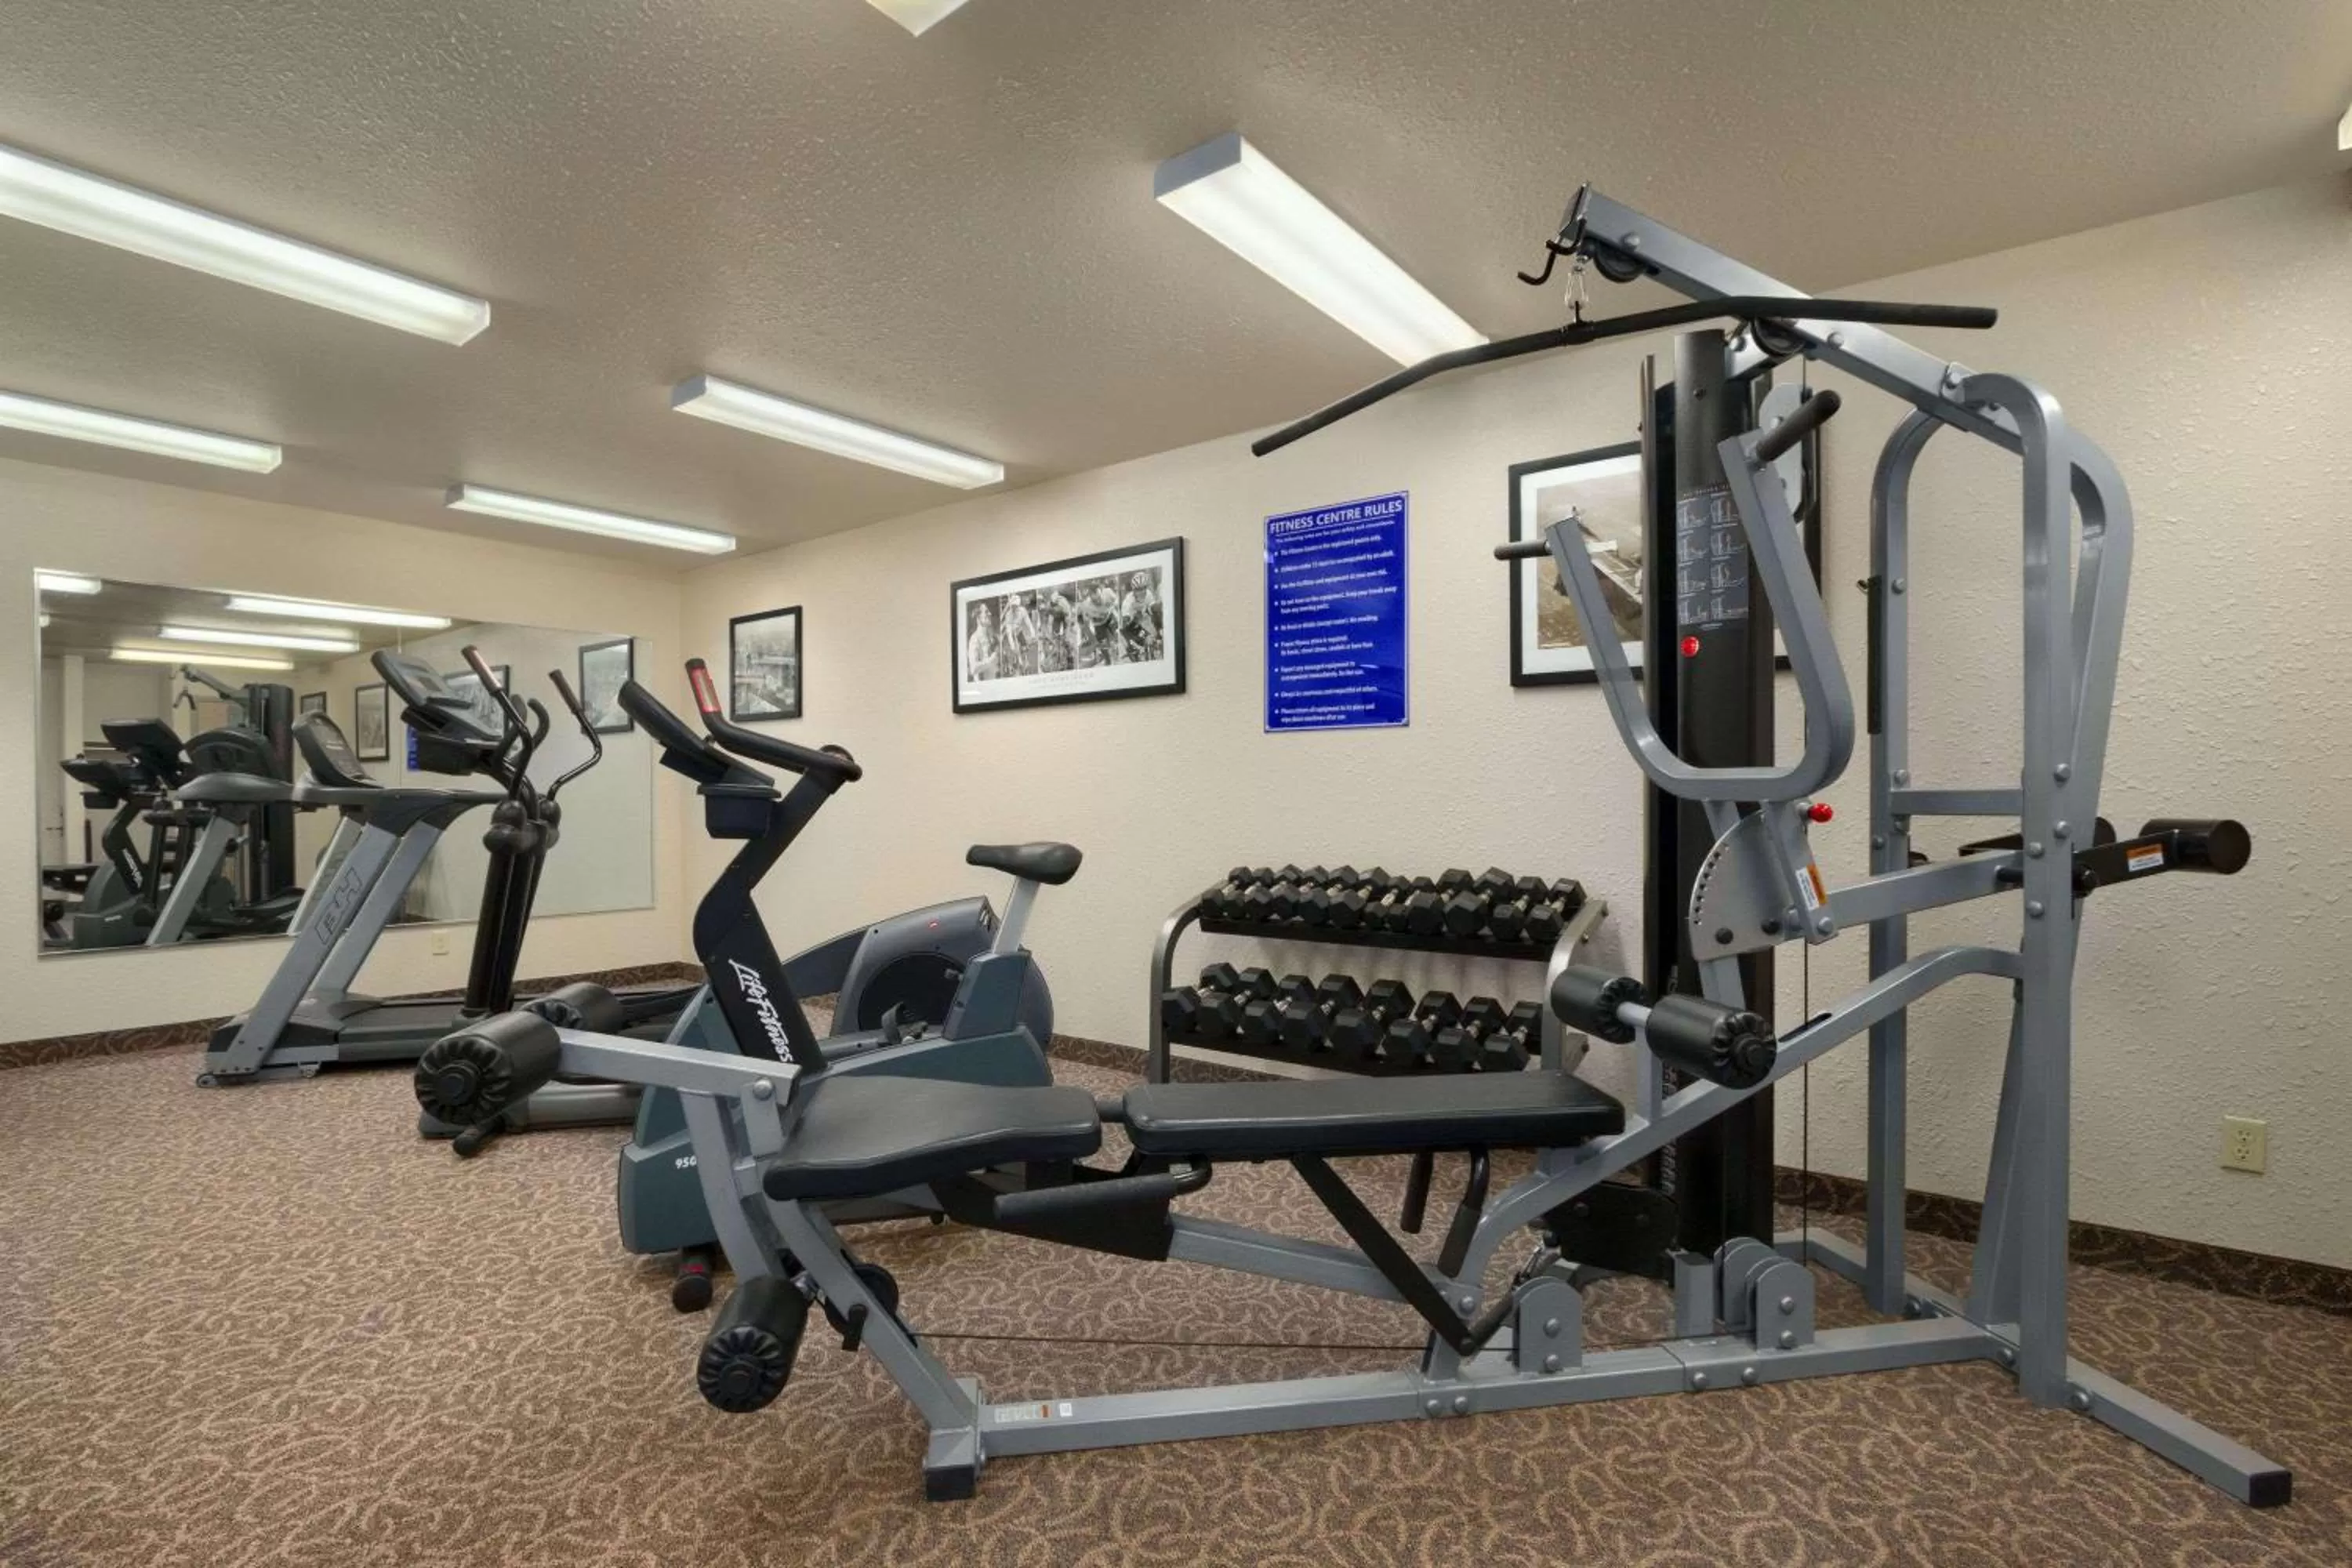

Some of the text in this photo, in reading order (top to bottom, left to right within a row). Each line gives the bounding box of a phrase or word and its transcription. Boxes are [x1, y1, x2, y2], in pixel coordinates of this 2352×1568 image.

[1269, 515, 1313, 534] FITNESS
[1316, 507, 1363, 525] CENTRE
[1364, 499, 1403, 517] RULES
